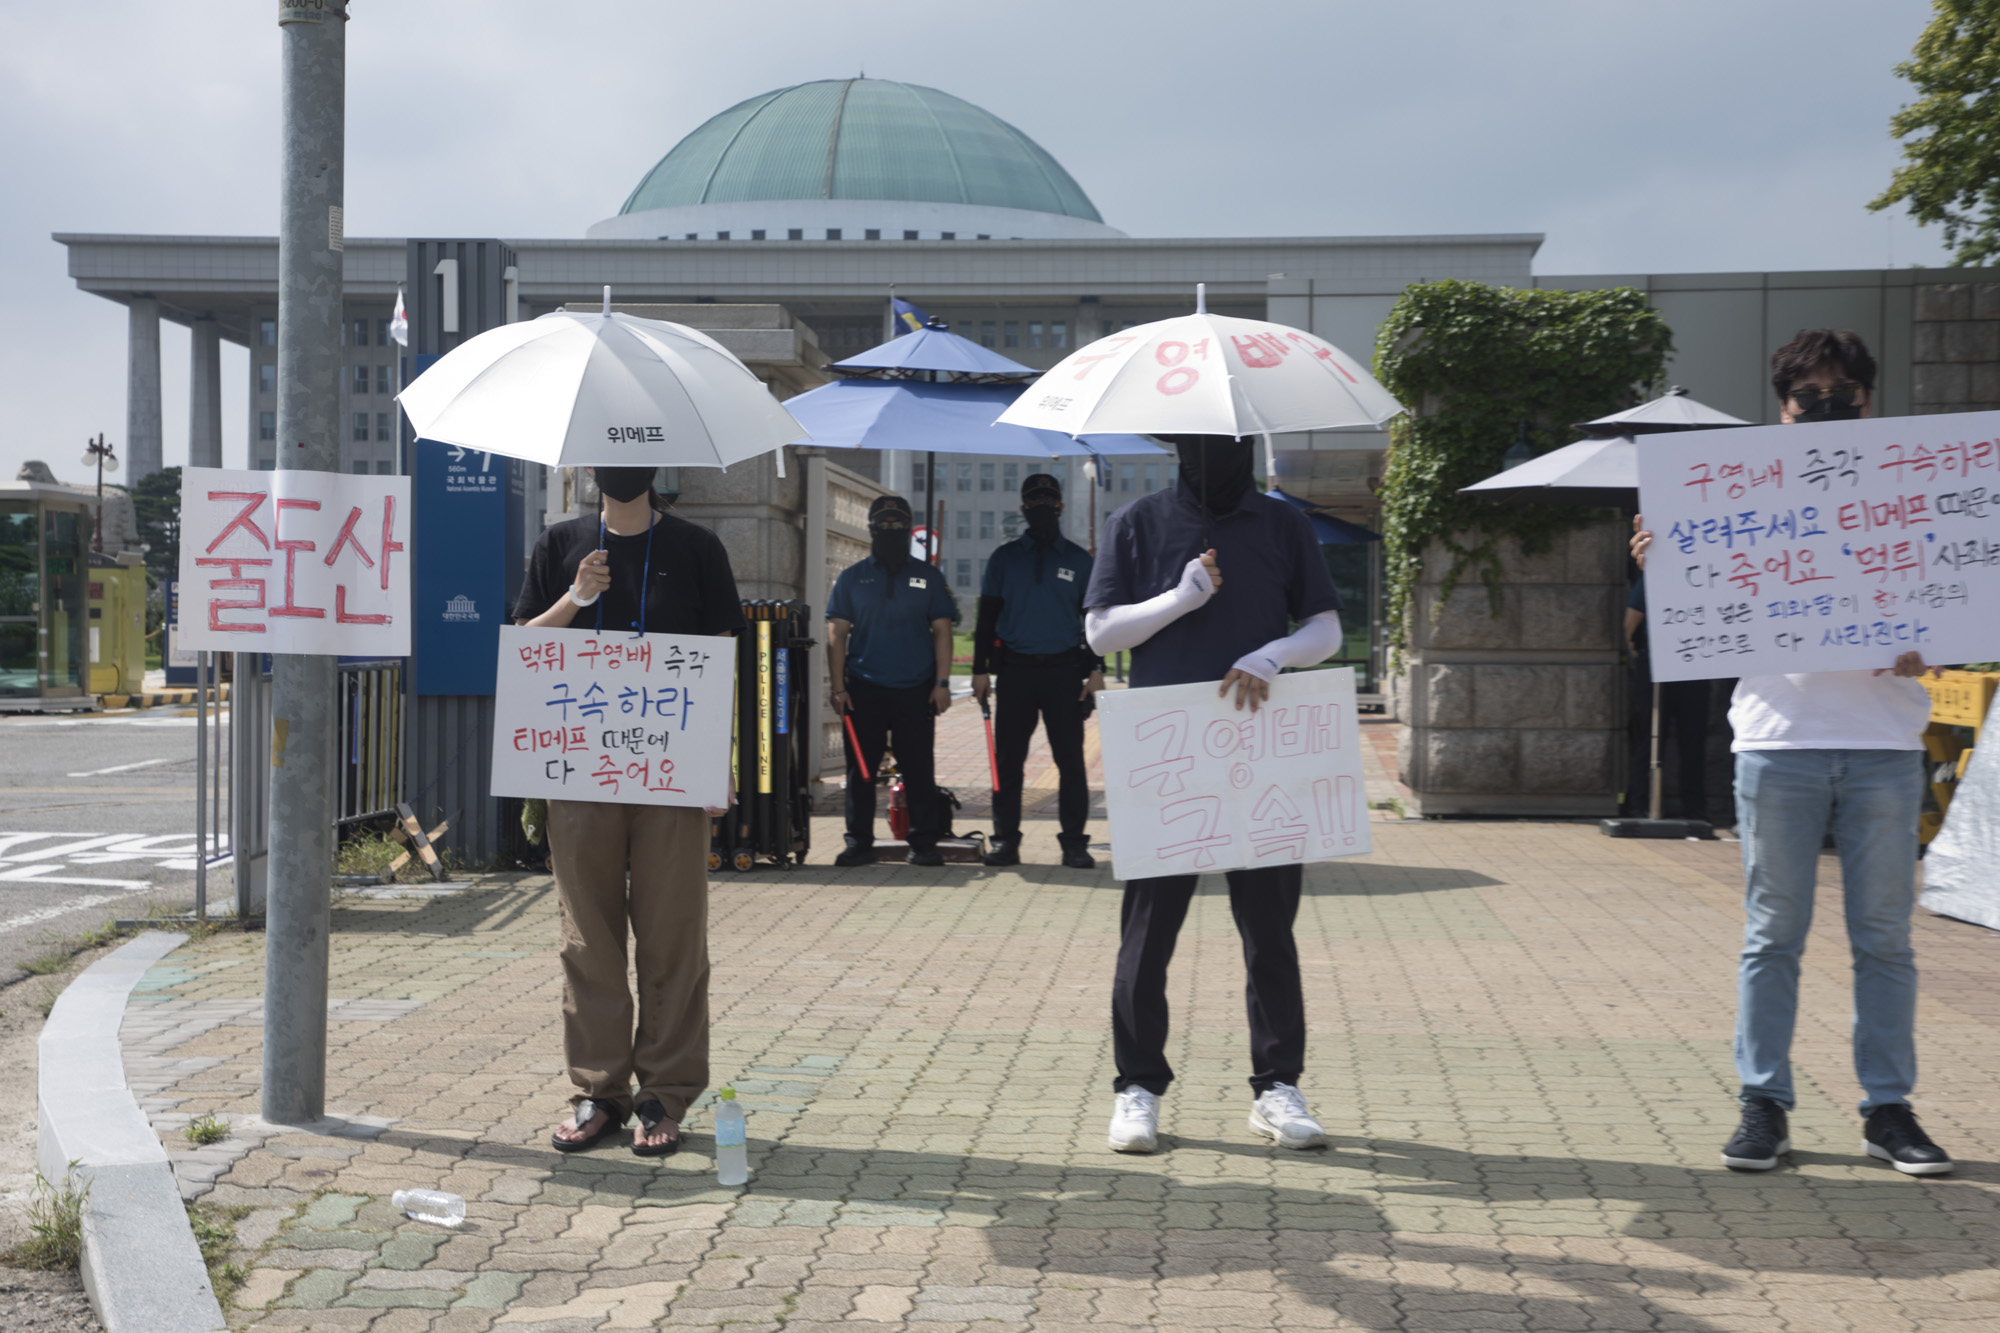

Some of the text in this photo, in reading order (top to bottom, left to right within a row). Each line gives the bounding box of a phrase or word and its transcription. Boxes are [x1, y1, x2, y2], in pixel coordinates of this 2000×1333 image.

[433, 259, 459, 332] 1
[607, 426, 665, 443] 위메프
[1684, 458, 1783, 503] 구영배
[1798, 447, 1863, 492] 즉각
[1667, 487, 2000, 555] 살려주세요 티메프 때문
[195, 491, 403, 634] 줄도산
[1685, 563, 1721, 589] 다
[1727, 549, 1836, 597] 죽어요
[1661, 604, 1706, 626] 20년
[1873, 589, 1900, 618] 한
[1904, 581, 1969, 609] 사람의
[519, 640, 710, 678] 먹튀 구영배 즉각
[1675, 633, 1757, 663] 농간으로
[1774, 632, 1804, 652] 다
[758, 652, 769, 776] POLICE LINE
[514, 726, 669, 755] 티메프 때문에
[1128, 703, 1341, 797] 구영배
[546, 754, 686, 795] 다 죽어요
